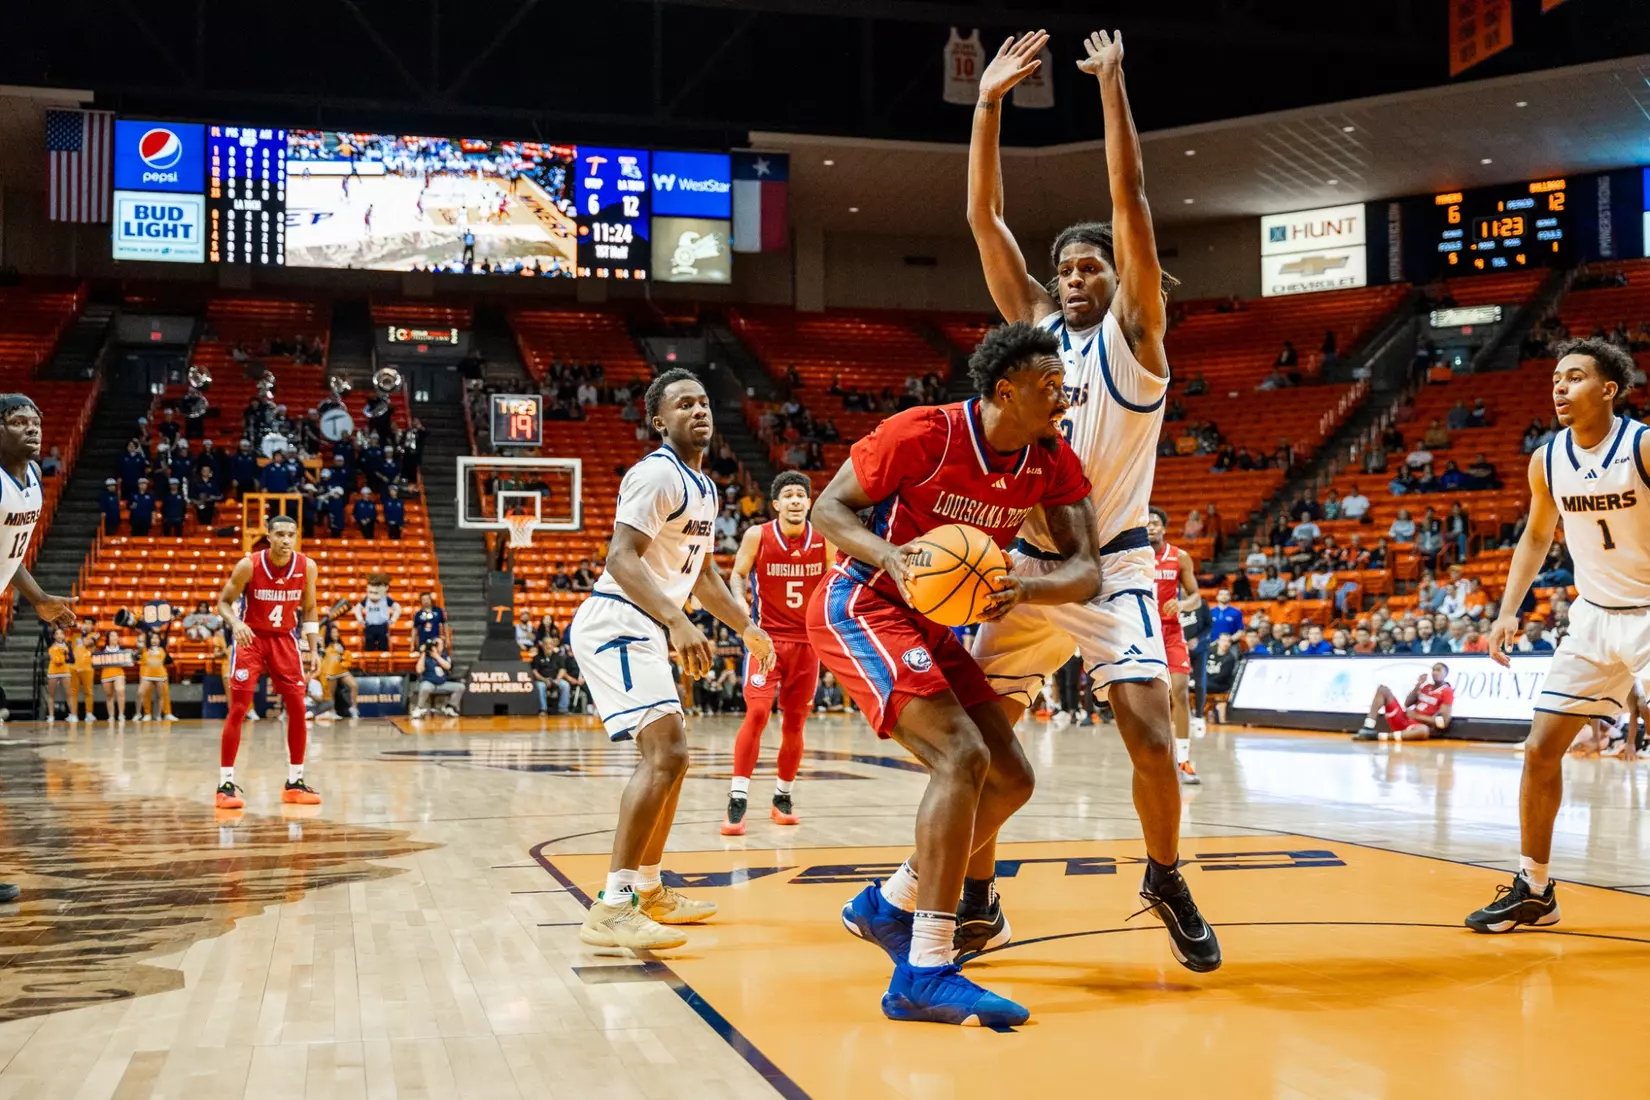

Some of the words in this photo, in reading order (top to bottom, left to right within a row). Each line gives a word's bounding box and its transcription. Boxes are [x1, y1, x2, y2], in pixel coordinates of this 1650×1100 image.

[955, 58, 975, 77] 10
[142, 171, 178, 184] pepsi
[678, 178, 731, 193] WestStar
[588, 193, 600, 216] 6
[622, 195, 640, 218] 12
[1497, 201, 1504, 212] 1
[1548, 192, 1565, 212] 12
[134, 205, 184, 222] BUD
[1448, 205, 1461, 224] 6
[124, 221, 194, 239] LIGHT
[592, 222, 634, 244] 11:24
[1291, 216, 1357, 240] HUNT
[1481, 216, 1524, 238] 11:23
[1552, 241, 1559, 253] 1
[510, 414, 532, 440] 19
[932, 490, 1005, 530] LOUISIANA
[1560, 489, 1638, 513] MINERS
[4, 509, 40, 526] MINERS
[1596, 519, 1616, 551] 1
[8, 531, 28, 560] 12
[766, 562, 805, 577] LOUISIANA
[805, 562, 823, 576] TECH
[254, 588, 287, 602] LOUISIANA
[286, 589, 302, 602] TECH
[785, 580, 804, 609] 5
[268, 604, 284, 628] 4
[92, 653, 133, 666] MINERS
[468, 682, 491, 693] SUR
[491, 682, 534, 693] PUEBLO
